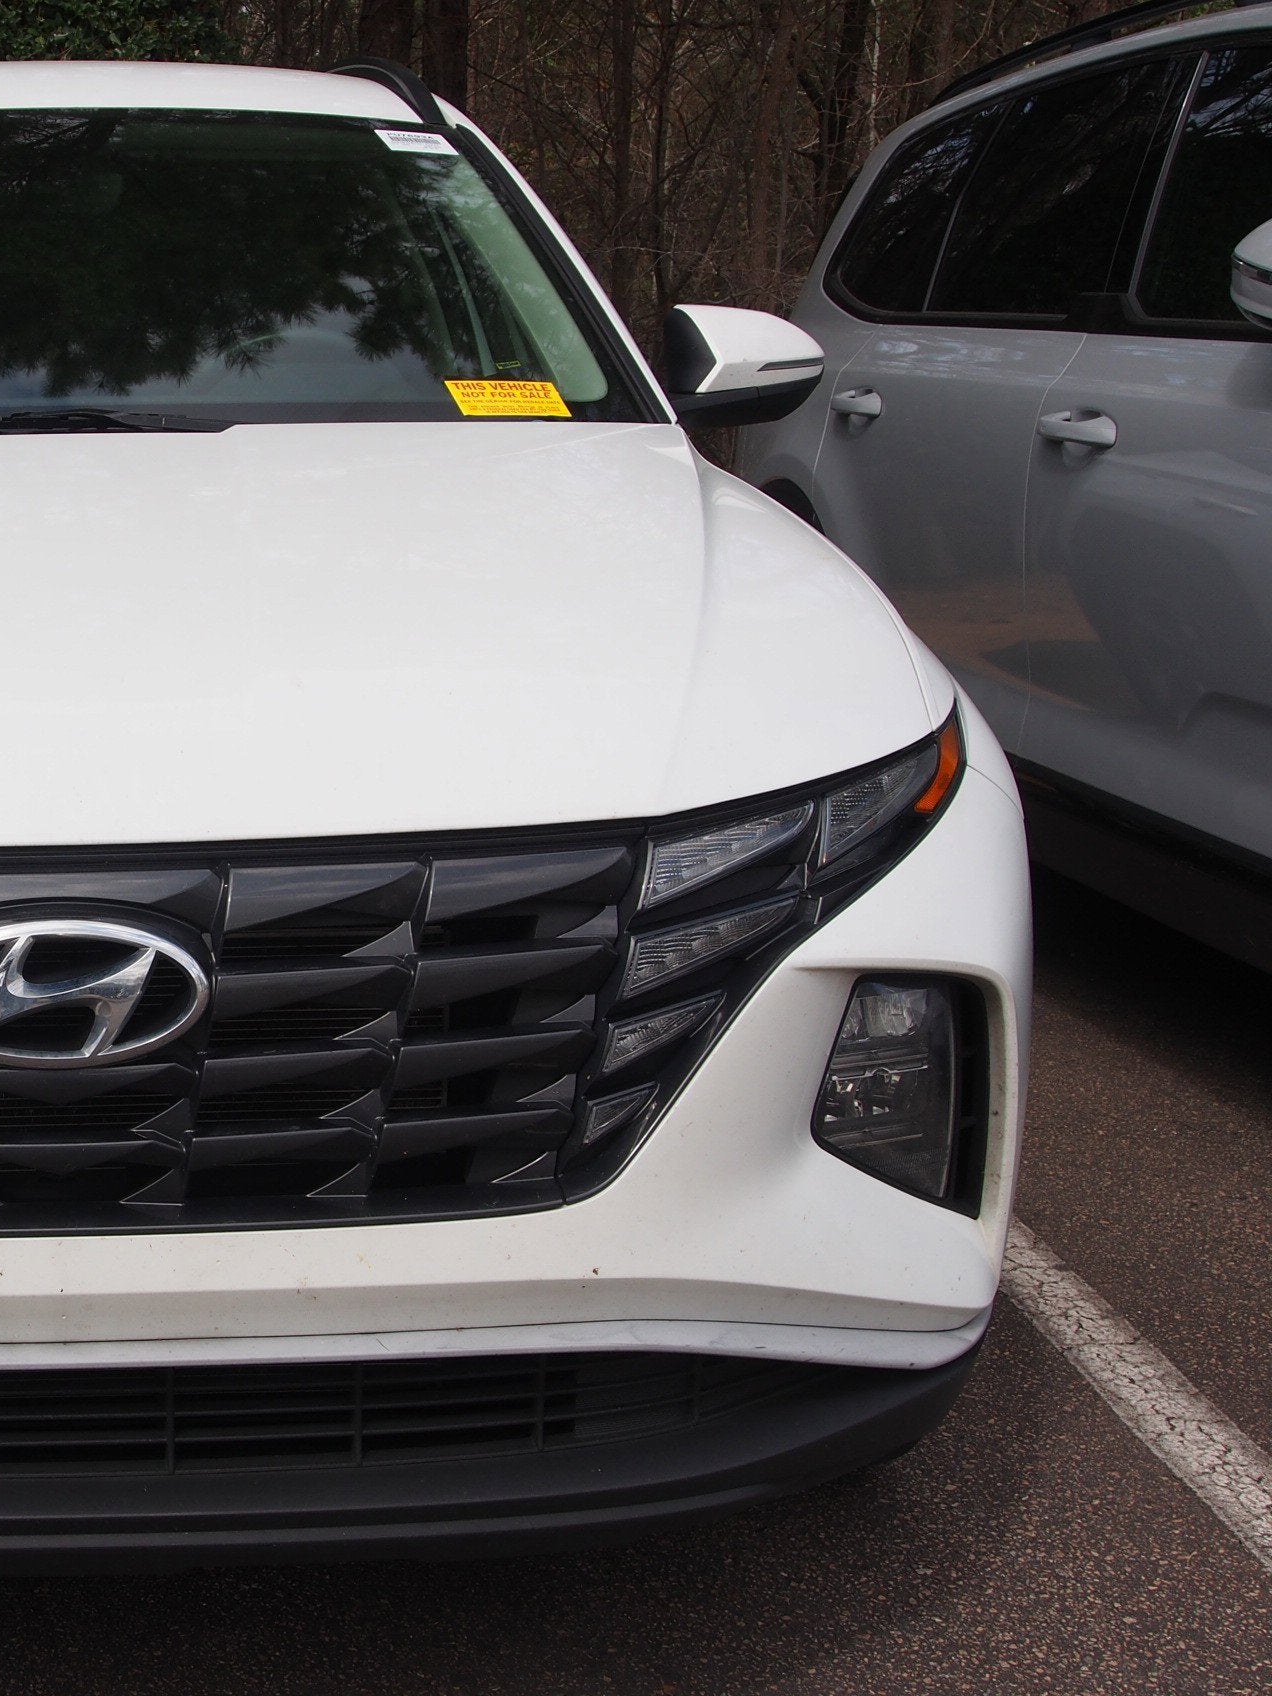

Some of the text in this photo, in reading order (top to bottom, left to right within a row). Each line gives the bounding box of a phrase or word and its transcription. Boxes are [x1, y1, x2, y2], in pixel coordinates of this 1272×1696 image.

[451, 382, 551, 392] THIS VEHICLE
[520, 391, 551, 399] SALE
